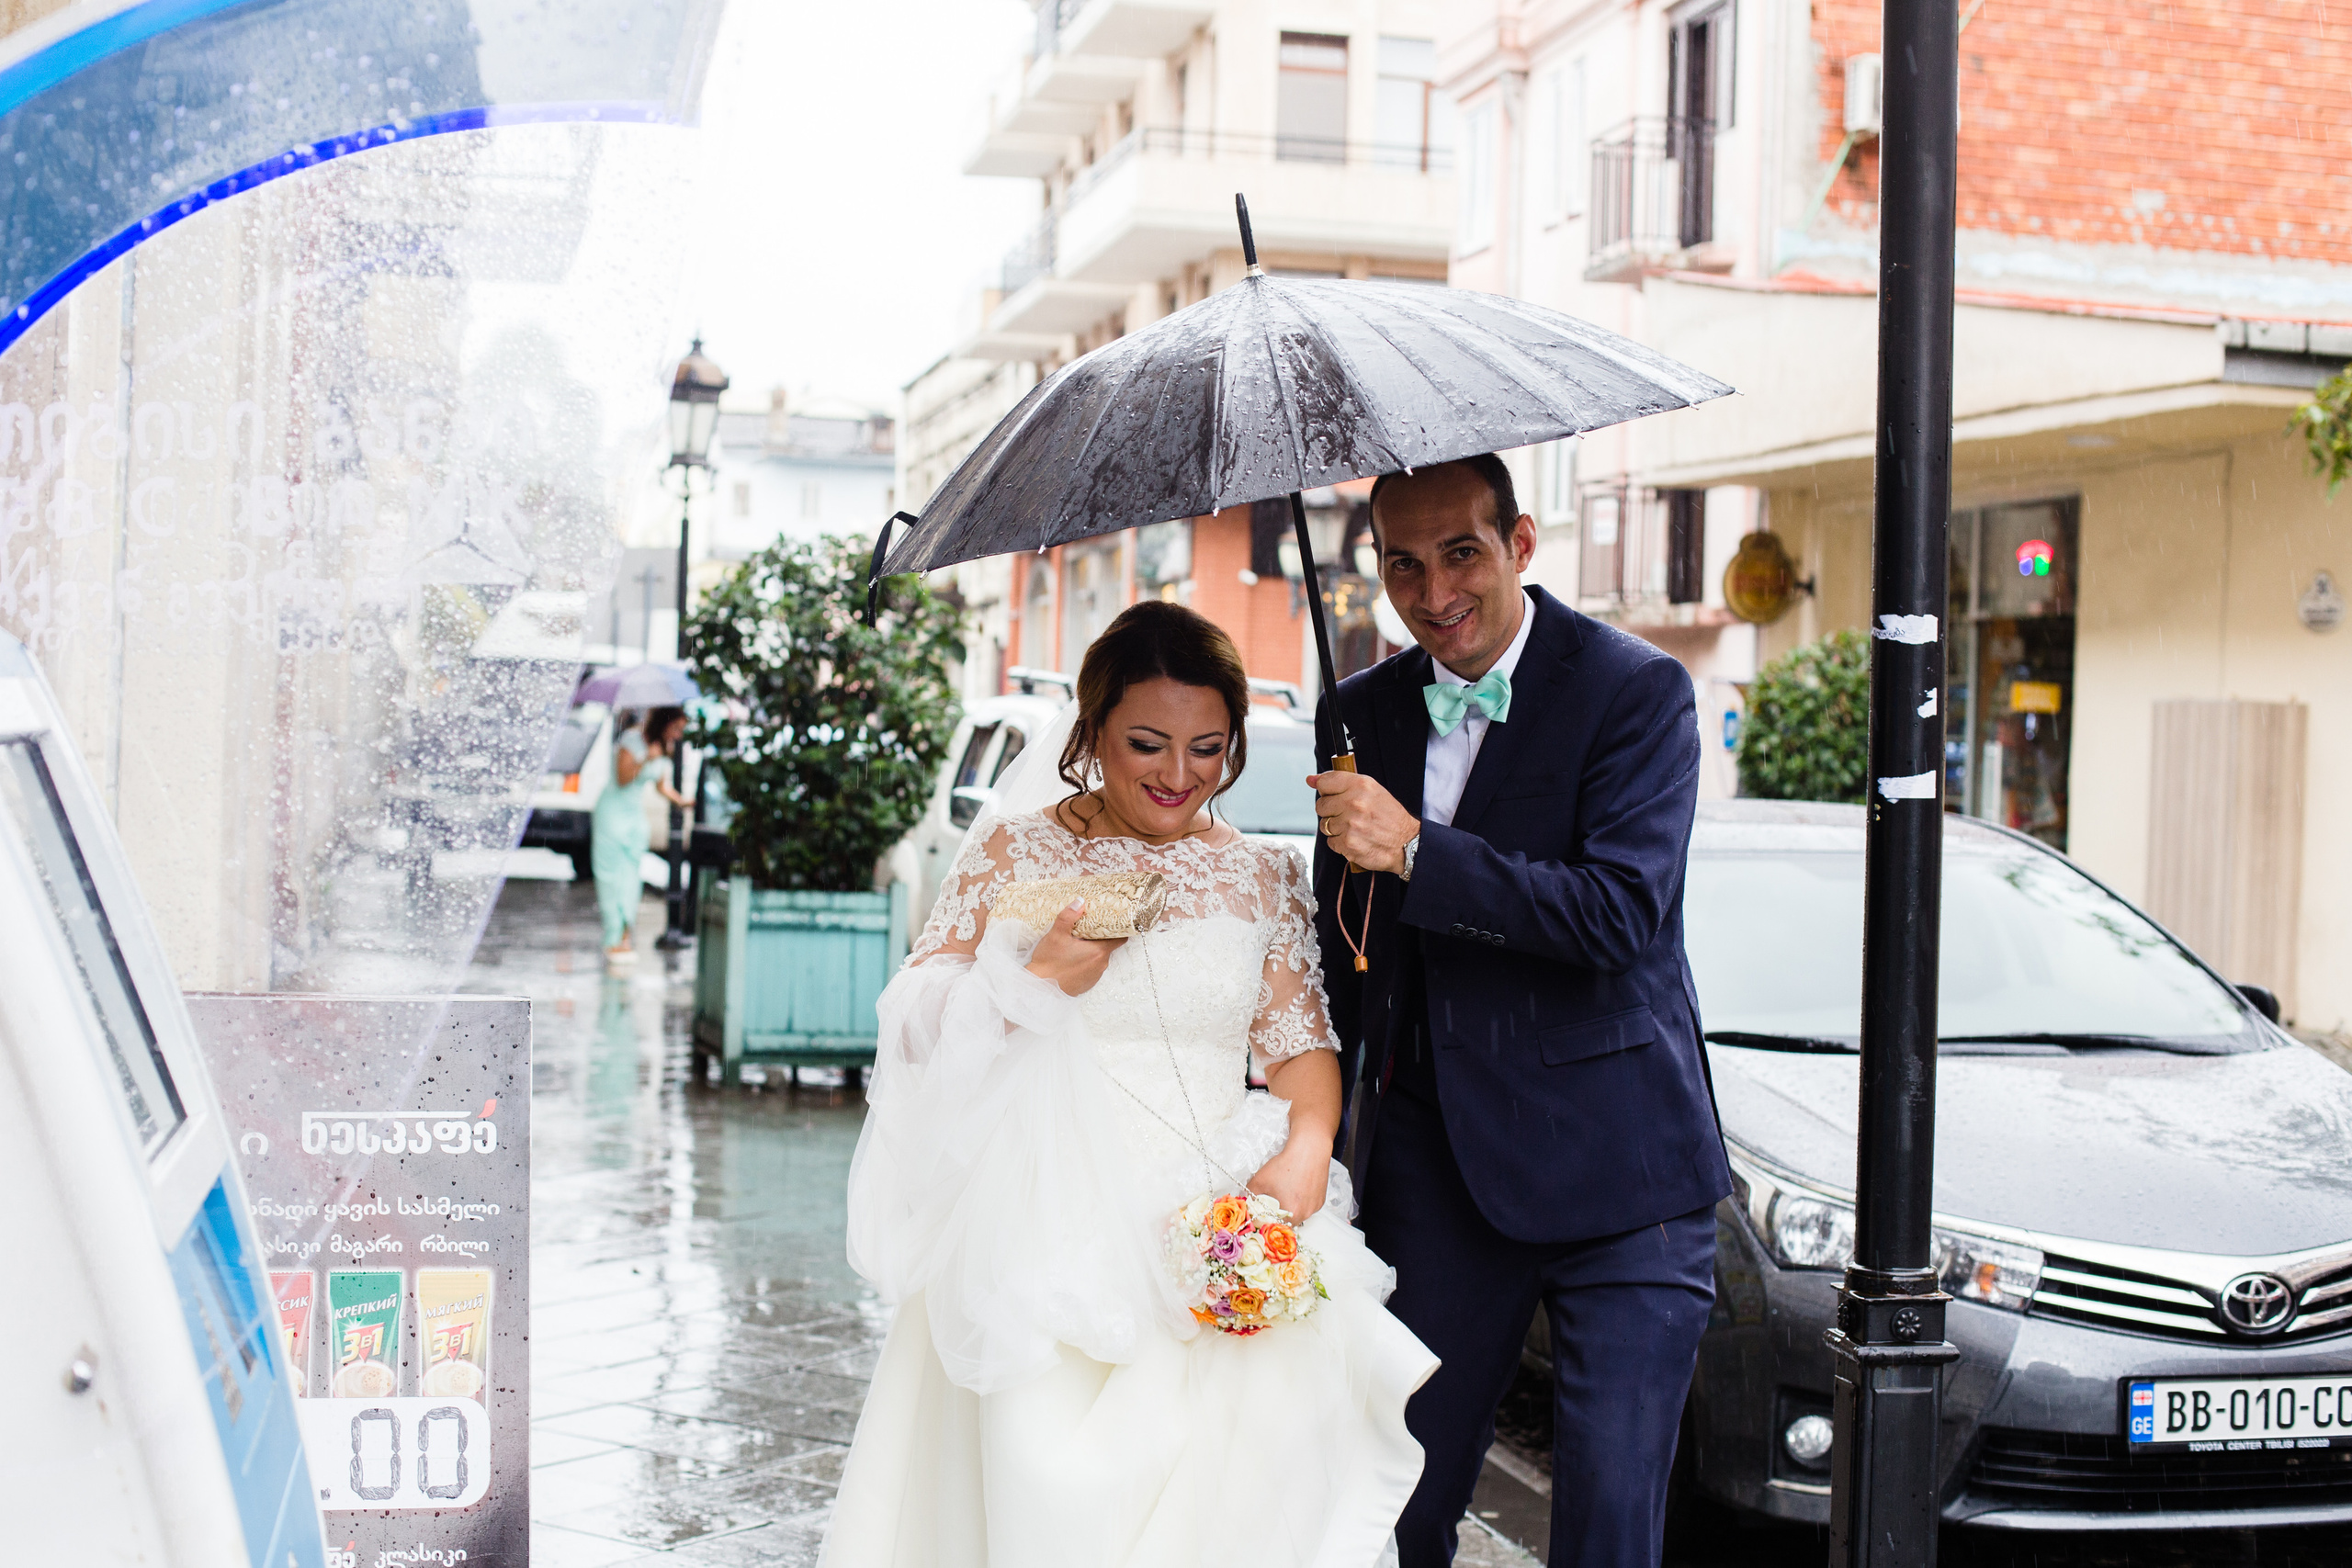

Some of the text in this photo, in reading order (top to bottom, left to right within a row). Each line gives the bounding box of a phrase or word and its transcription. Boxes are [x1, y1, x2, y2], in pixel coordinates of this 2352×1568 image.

[324, 1197, 391, 1223] ყავის
[398, 1197, 501, 1222] სასმელი
[331, 1234, 403, 1258] მაგარი
[420, 1234, 490, 1259] რბილი
[334, 1292, 398, 1320] КРЕПКИЙ
[424, 1292, 484, 1320] МЯГКИЙ
[2132, 1416, 2154, 1435] GE
[2188, 1441, 2224, 1452] TOYOTA
[2226, 1440, 2262, 1450] CENTER
[2265, 1439, 2295, 1450] TBILISI
